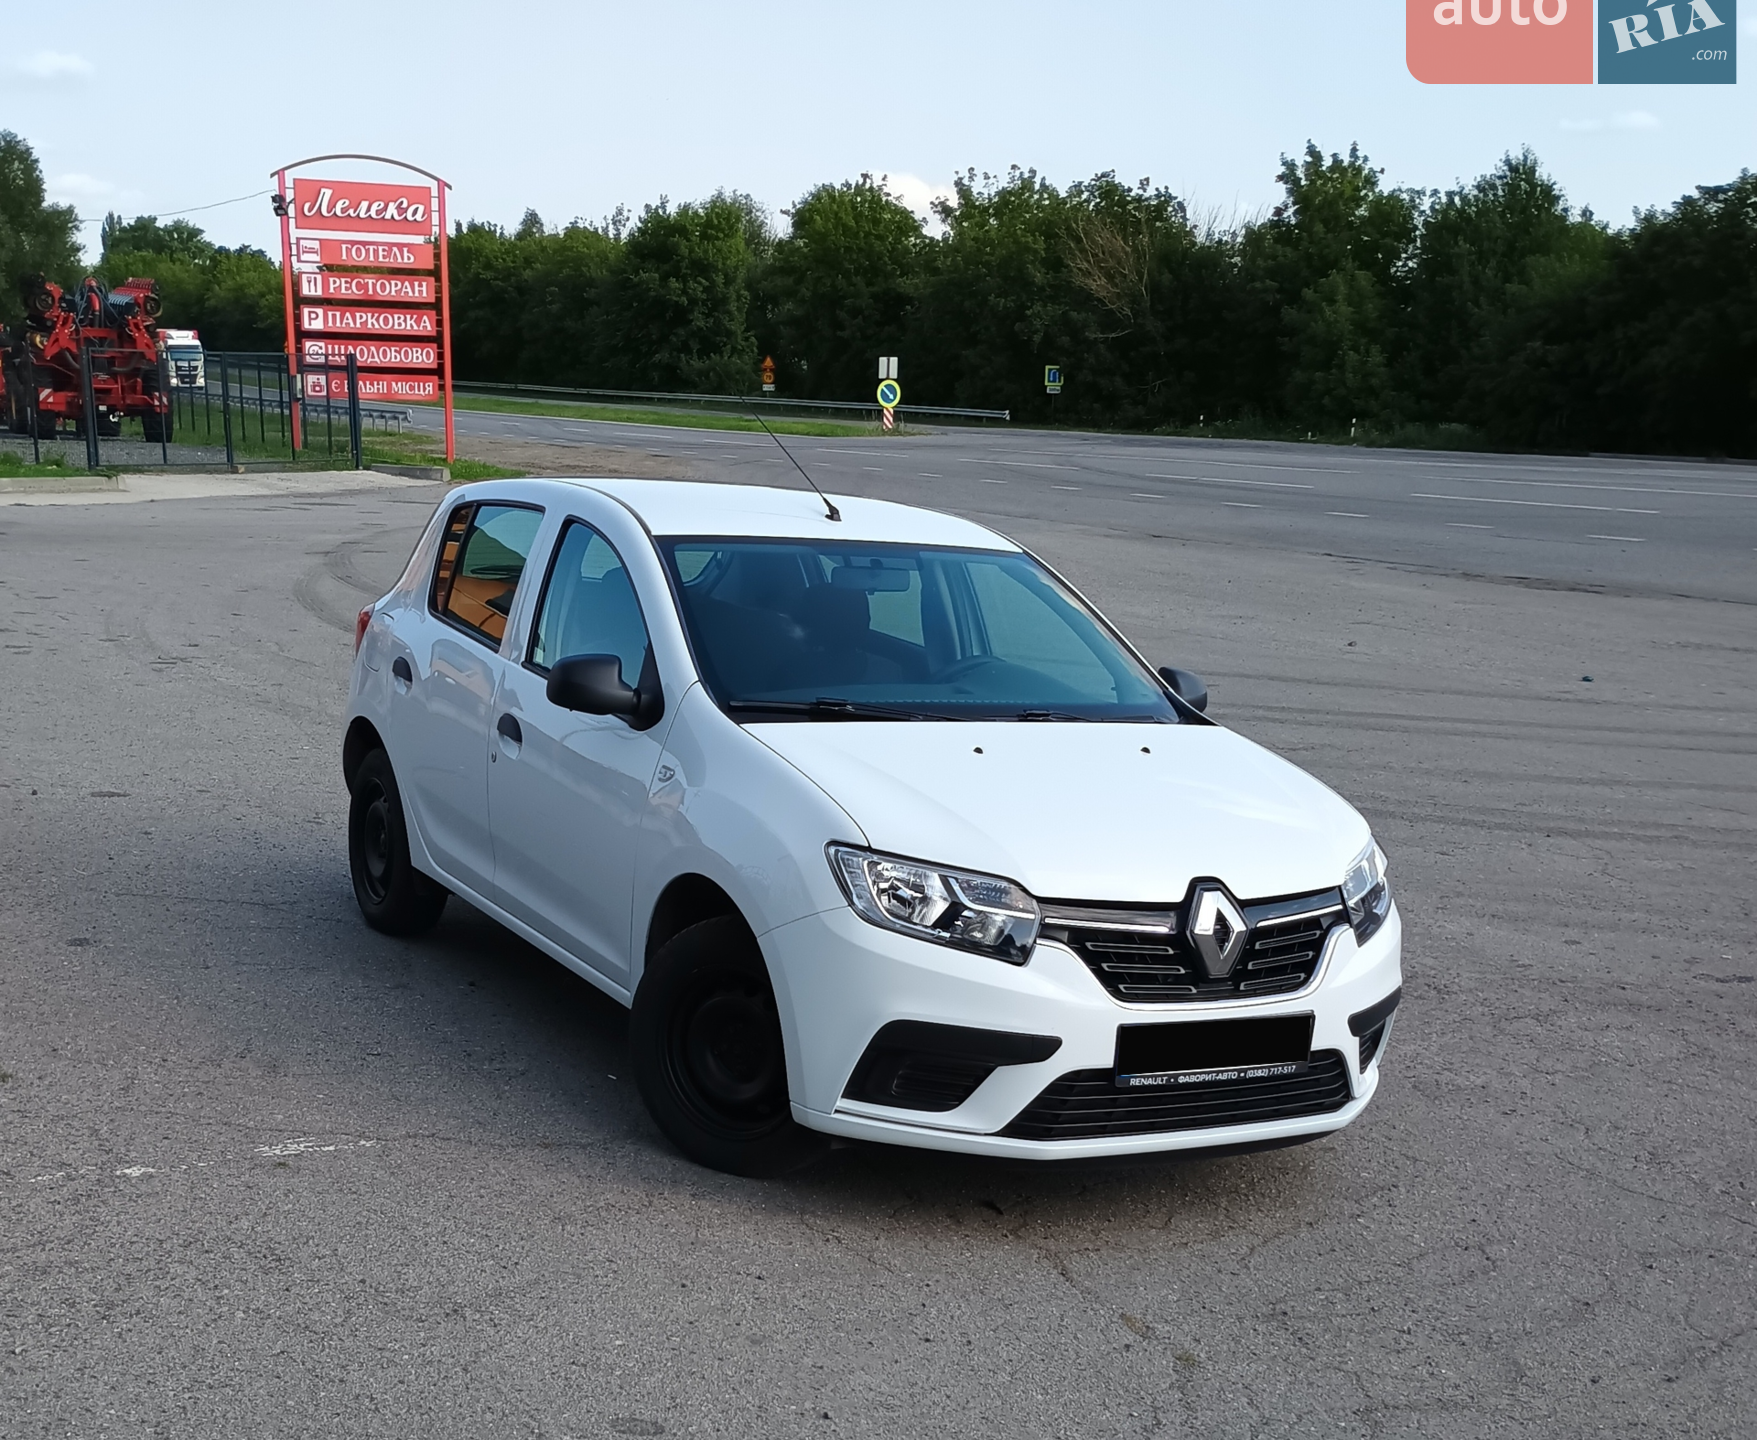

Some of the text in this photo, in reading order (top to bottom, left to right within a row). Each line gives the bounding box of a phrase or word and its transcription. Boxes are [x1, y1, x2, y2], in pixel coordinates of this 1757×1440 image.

[303, 187, 428, 222] Лелека
[341, 243, 415, 264] ГОТЕЛЬ
[328, 277, 428, 298] РЕСТОРАН
[327, 310, 433, 331] ПАРКОВКА
[391, 381, 434, 396] МІСЦЯ
[1129, 1076, 1168, 1086] RENAULT
[1245, 1068, 1269, 1079] (0382)
